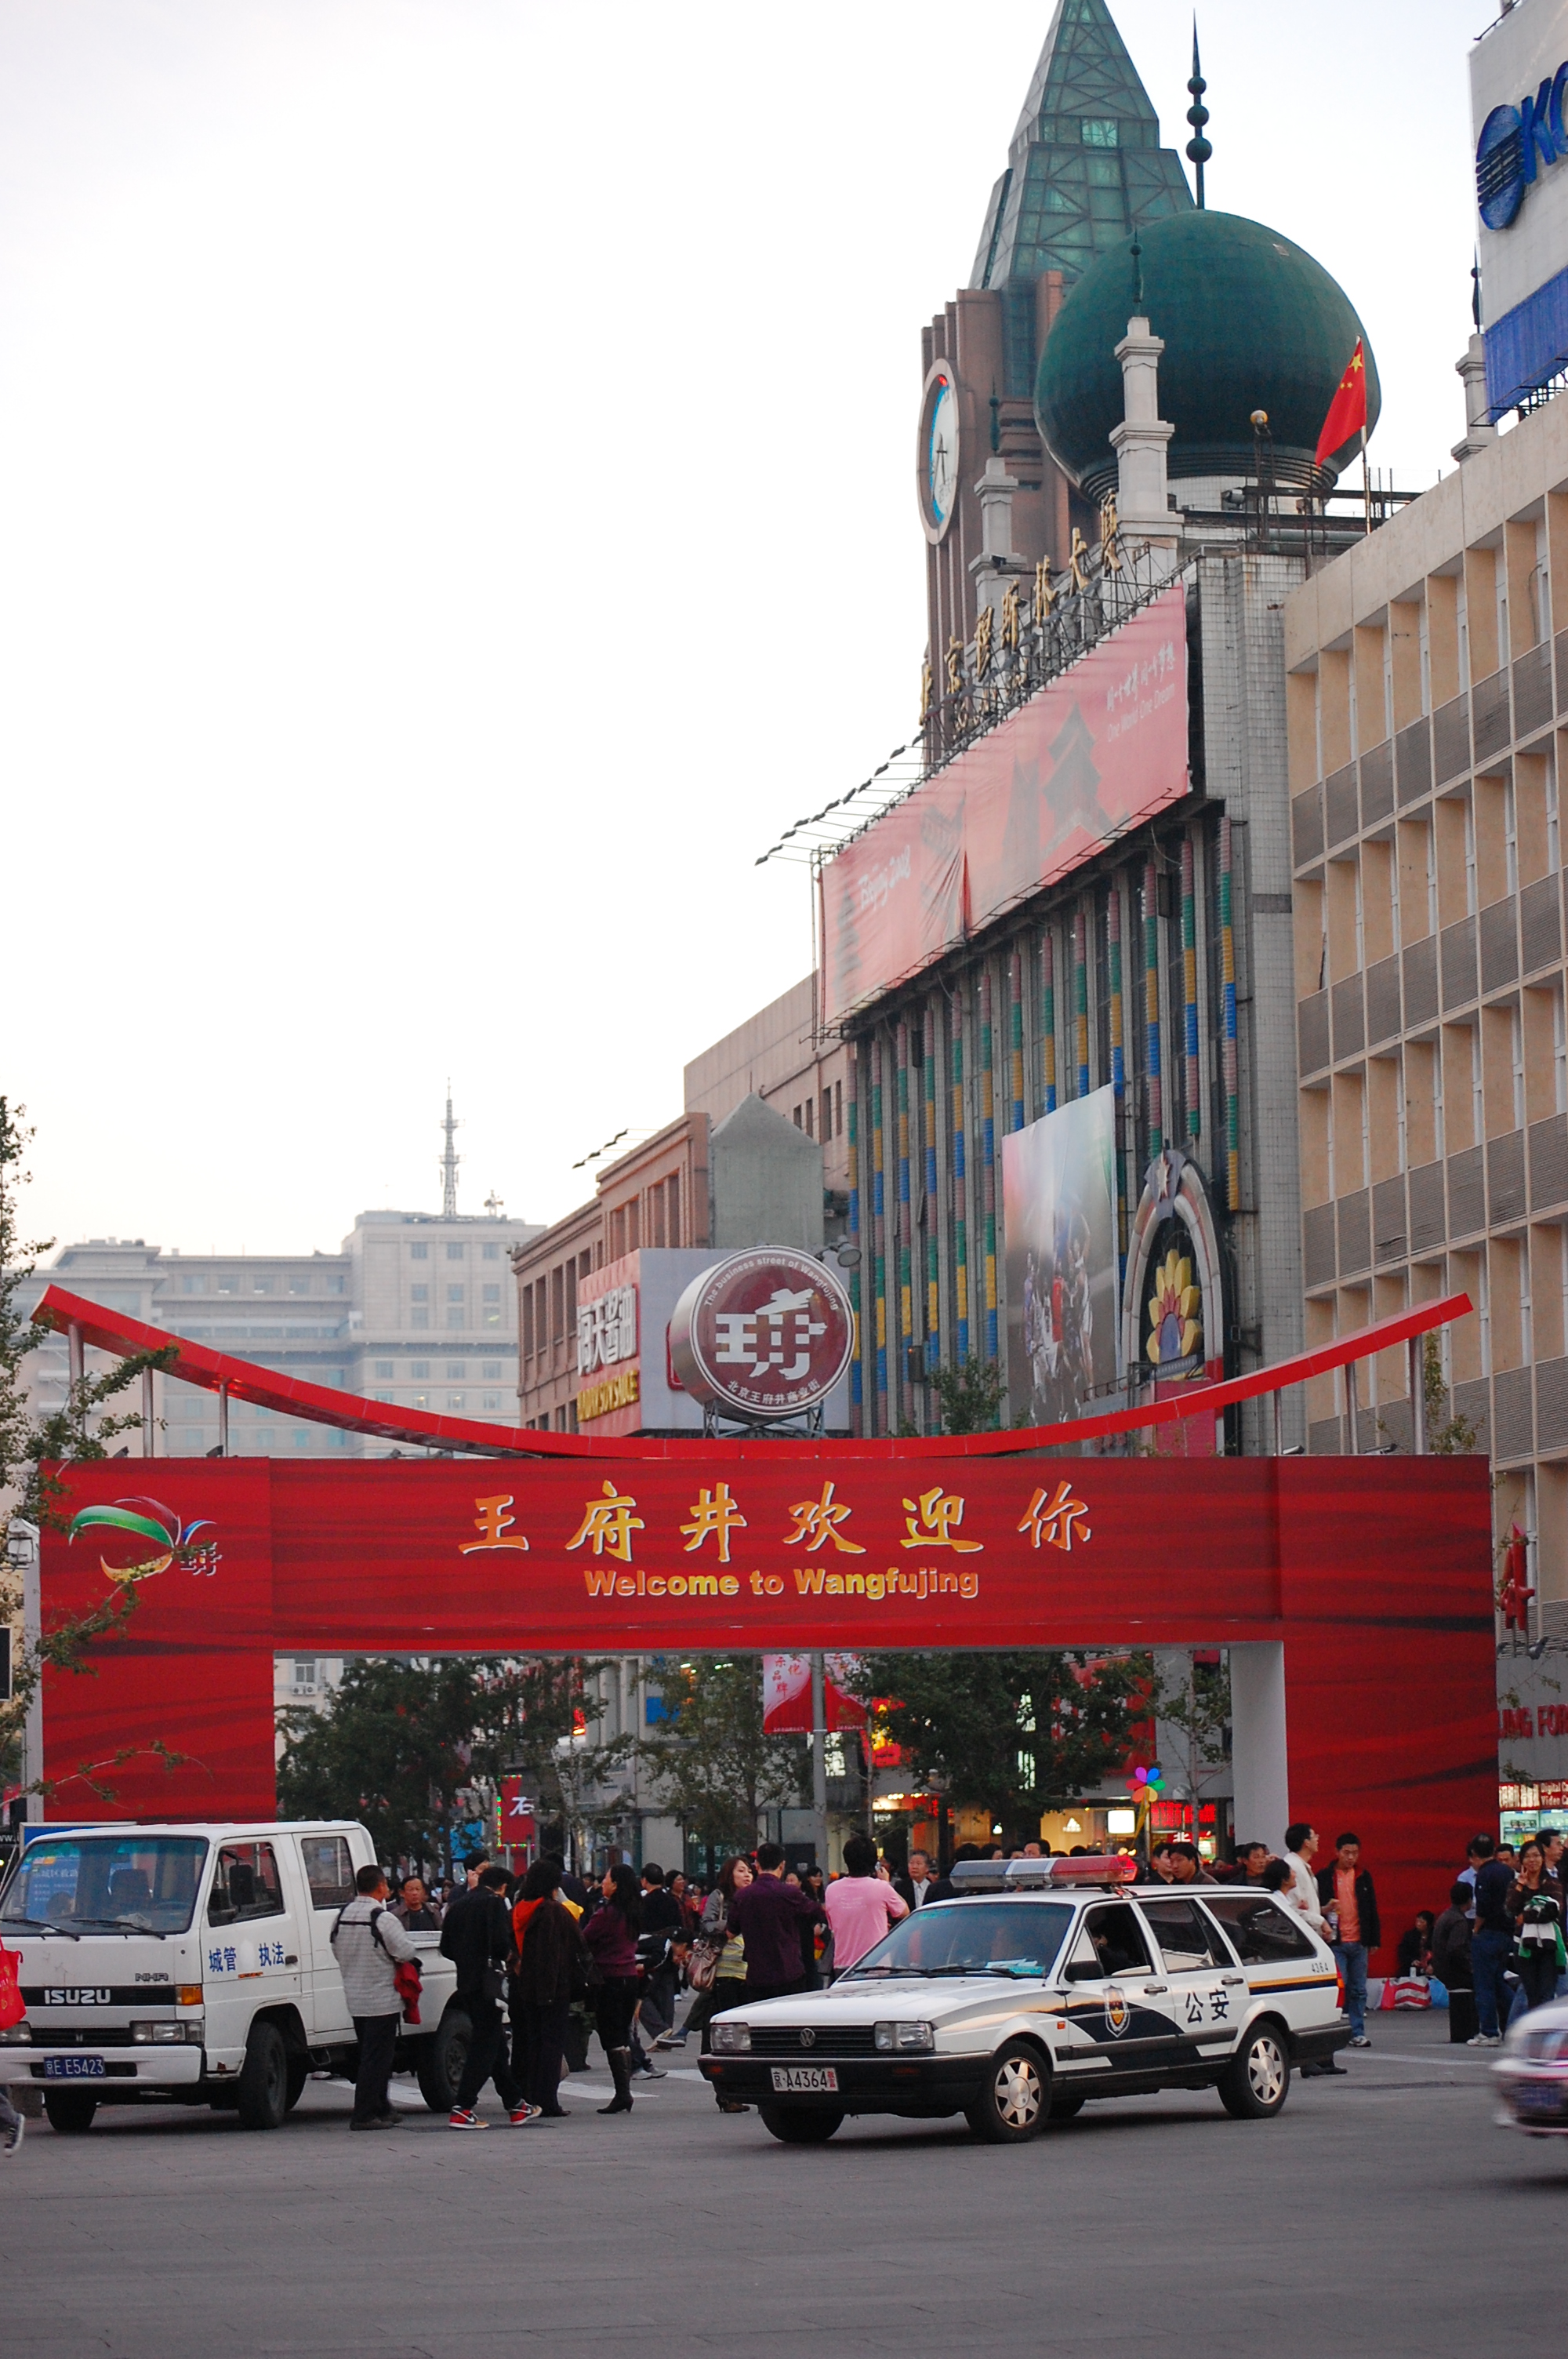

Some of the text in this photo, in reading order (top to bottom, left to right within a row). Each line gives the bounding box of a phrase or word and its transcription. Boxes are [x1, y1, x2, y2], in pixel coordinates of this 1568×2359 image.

[704, 1256, 839, 1311] The business street of Wangfujing
[727, 1378, 821, 1405] 北京王府井商业街
[458, 1480, 1093, 1563] 王府井欢迎你
[583, 1567, 979, 1601] Welcome to Wangfujing
[209, 1941, 285, 1972] 城管 执法
[1311, 1962, 1329, 1972] 4364
[135, 1972, 169, 1982] NHR
[44, 1989, 111, 2005] ISUZU
[1185, 1987, 1230, 2024] 公安
